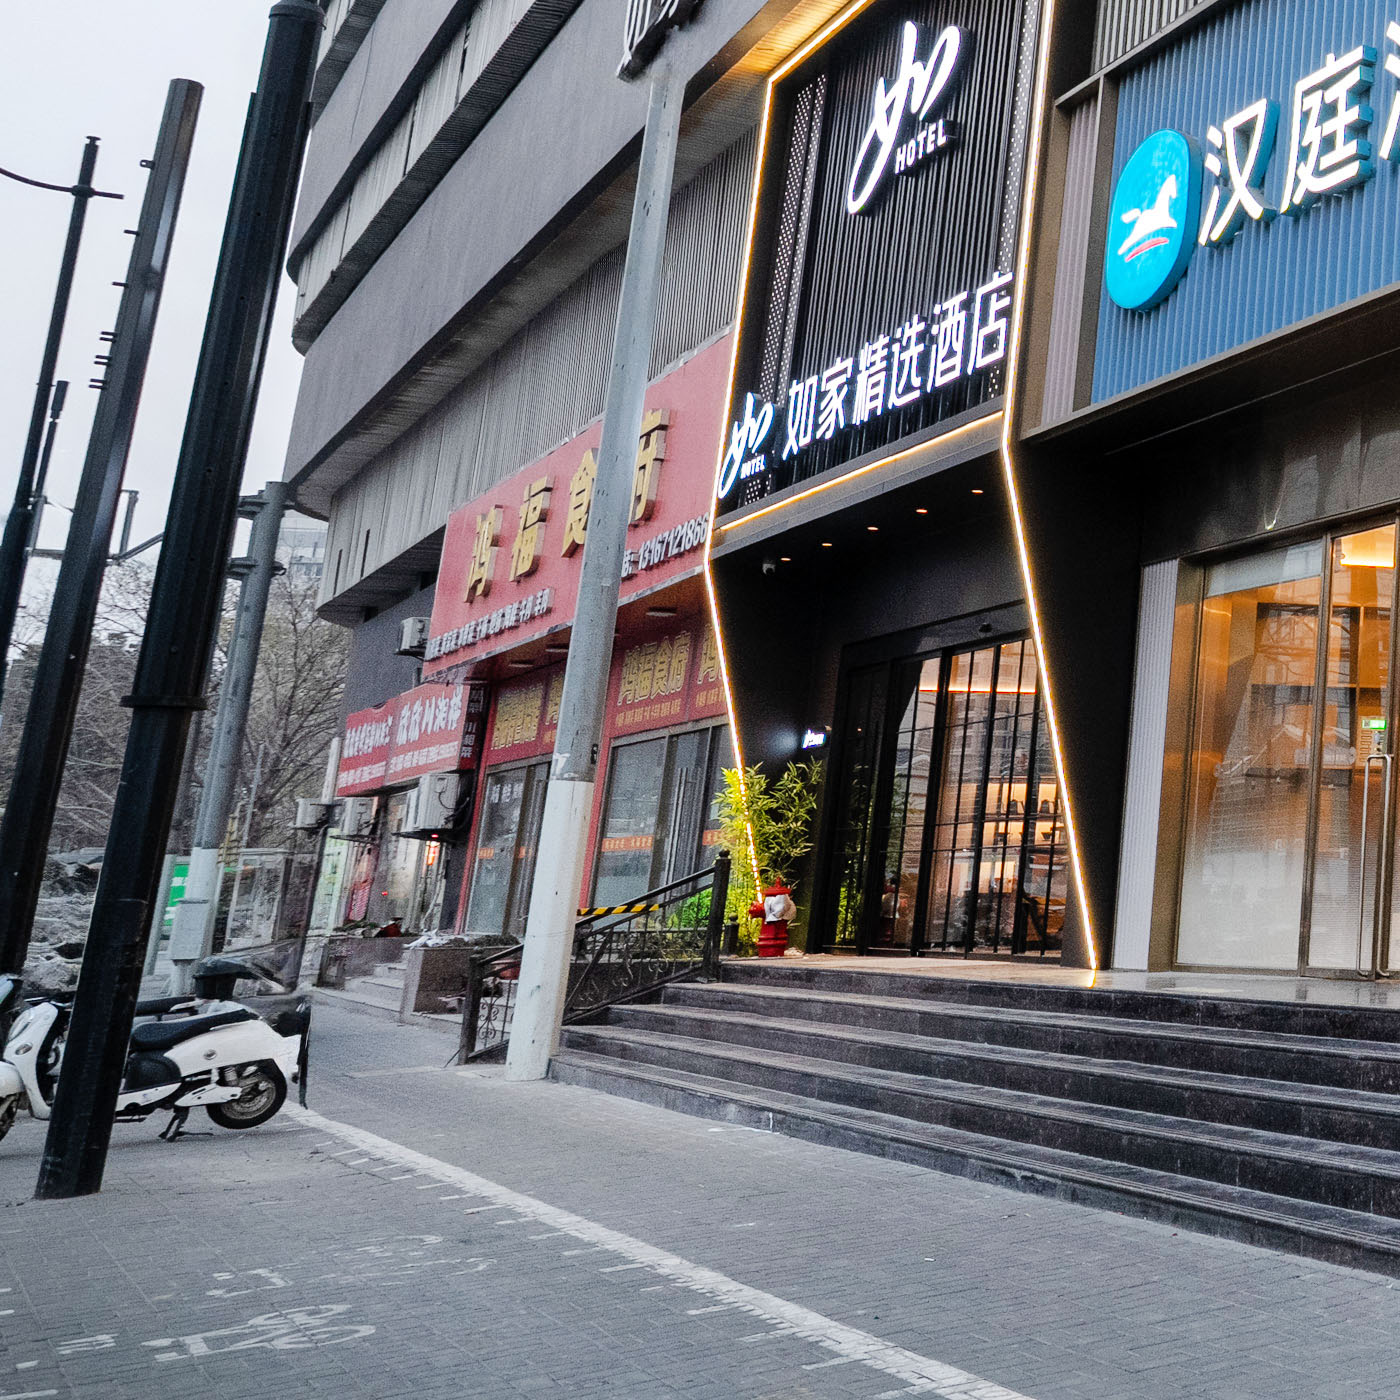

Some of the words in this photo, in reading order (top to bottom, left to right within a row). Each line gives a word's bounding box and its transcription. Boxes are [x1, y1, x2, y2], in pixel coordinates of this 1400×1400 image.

[895, 118, 949, 175] HOTEL
[782, 271, 1013, 461] 如家精选酒店
[740, 455, 766, 480] HOTEL
